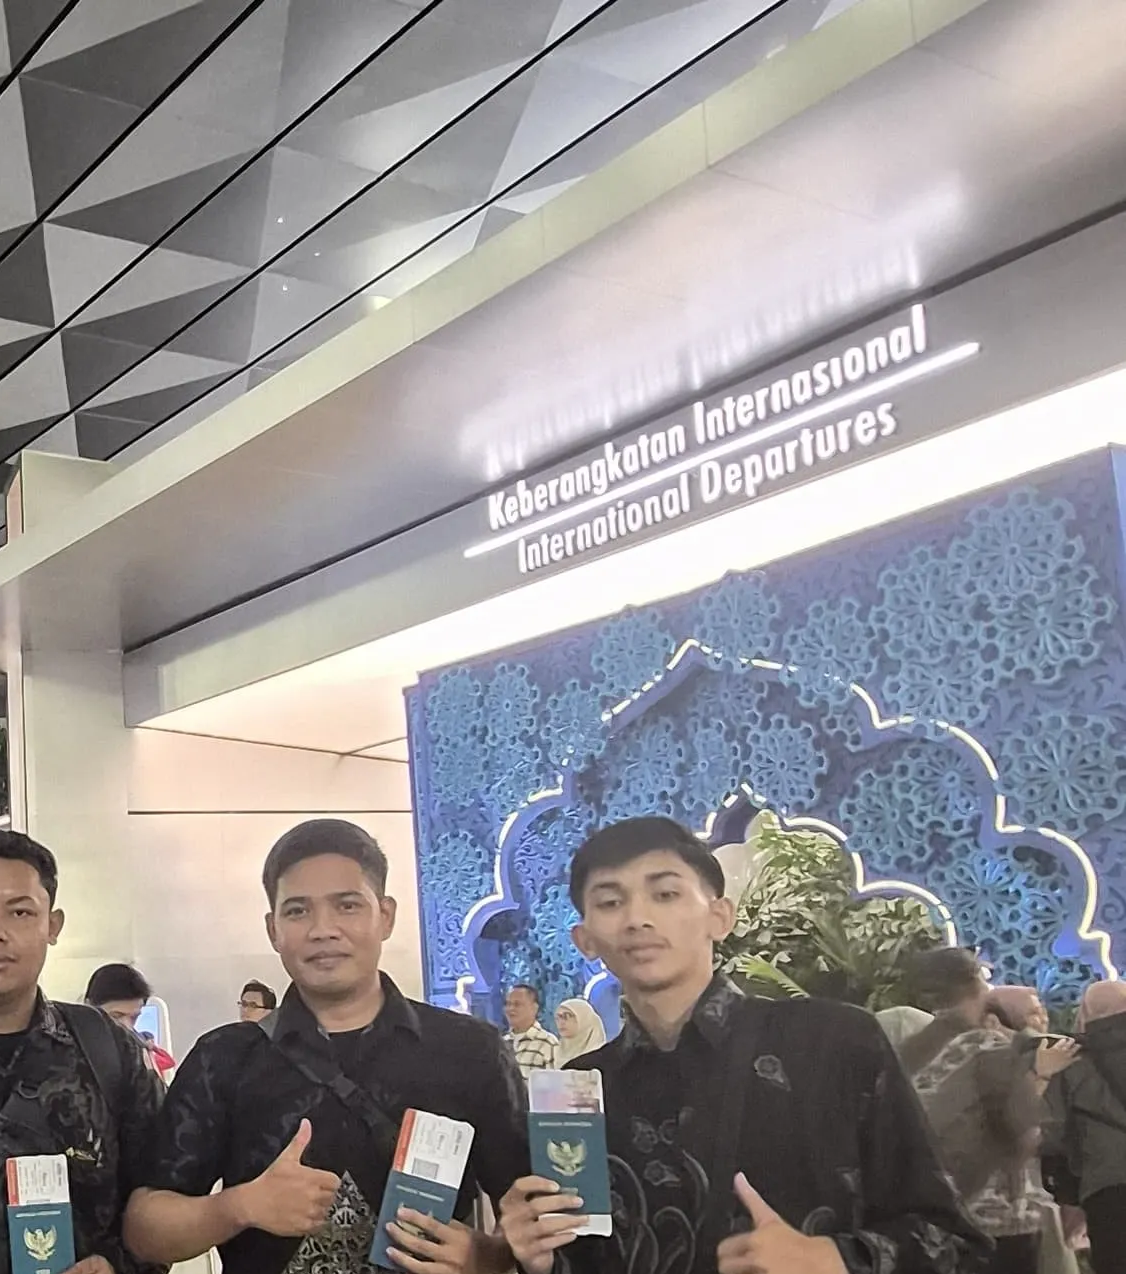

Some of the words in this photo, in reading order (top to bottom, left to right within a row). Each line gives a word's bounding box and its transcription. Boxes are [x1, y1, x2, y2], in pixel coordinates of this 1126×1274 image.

[488, 425, 686, 530] Keberangkatan
[694, 303, 927, 444] Internasional
[518, 472, 690, 573] International
[700, 402, 897, 503] Departures
